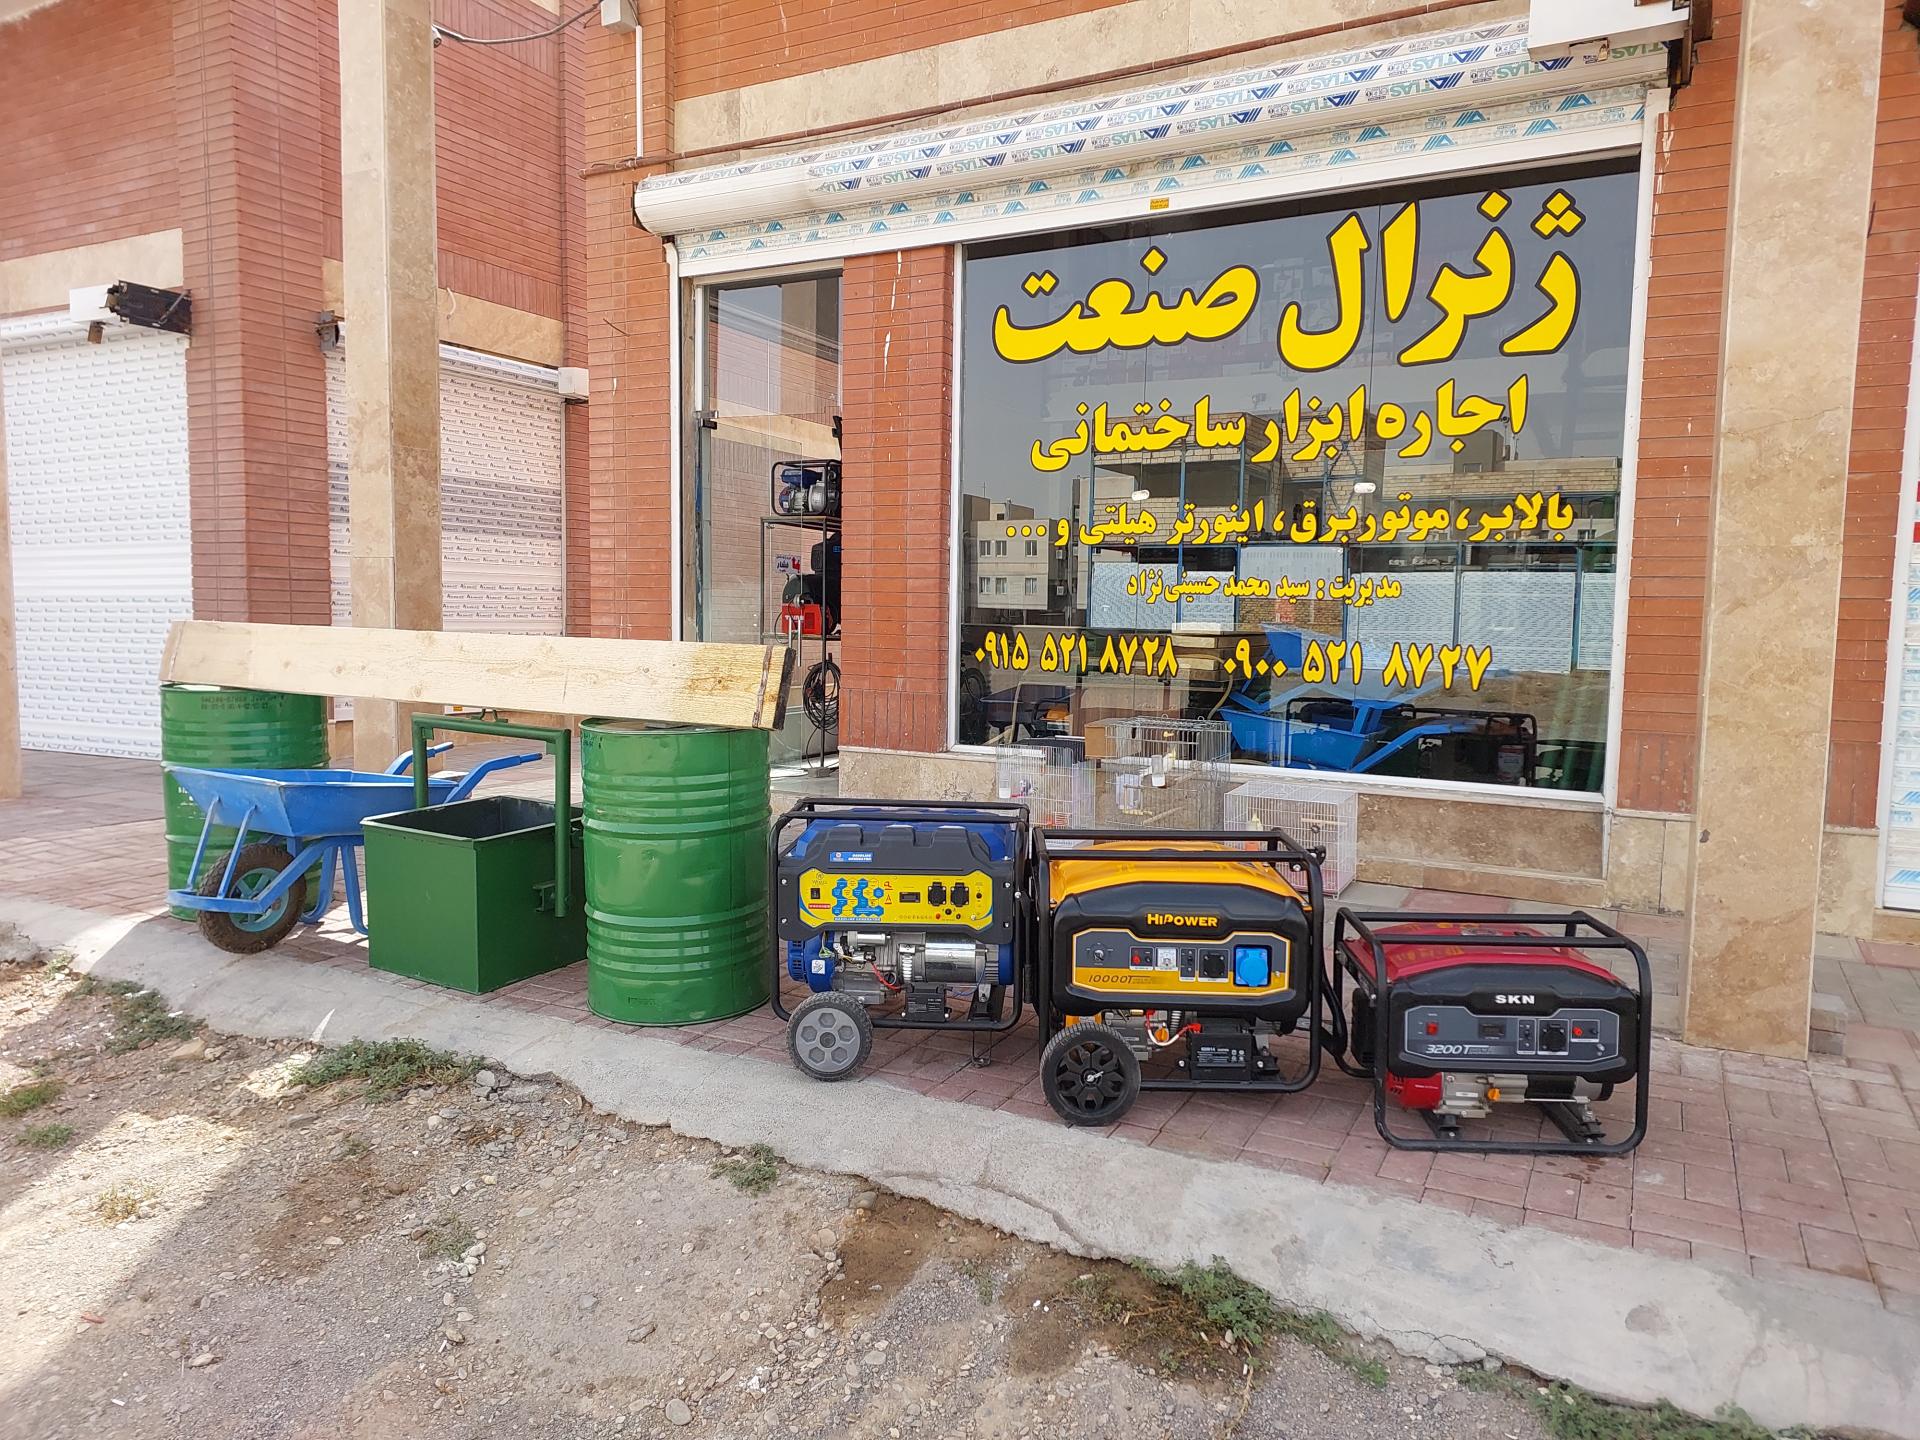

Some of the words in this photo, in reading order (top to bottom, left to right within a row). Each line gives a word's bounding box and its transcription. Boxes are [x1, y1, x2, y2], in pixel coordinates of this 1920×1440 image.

[1277, 189, 1585, 372] ژنرال
[992, 246, 1261, 364] صنعت
[1029, 395, 1248, 473] ساختمانی
[1248, 384, 1367, 464] ابزار
[1373, 374, 1529, 459] اجاره
[1053, 516, 1071, 548] و
[1078, 502, 1159, 546] هیلتی
[1166, 498, 1266, 546] اینورتر
[1222, 573, 1272, 599] محمد
[1274, 574, 1312, 605] سید
[1494, 994, 1536, 1005] SKN
[1425, 1044, 1470, 1056] 3200T
